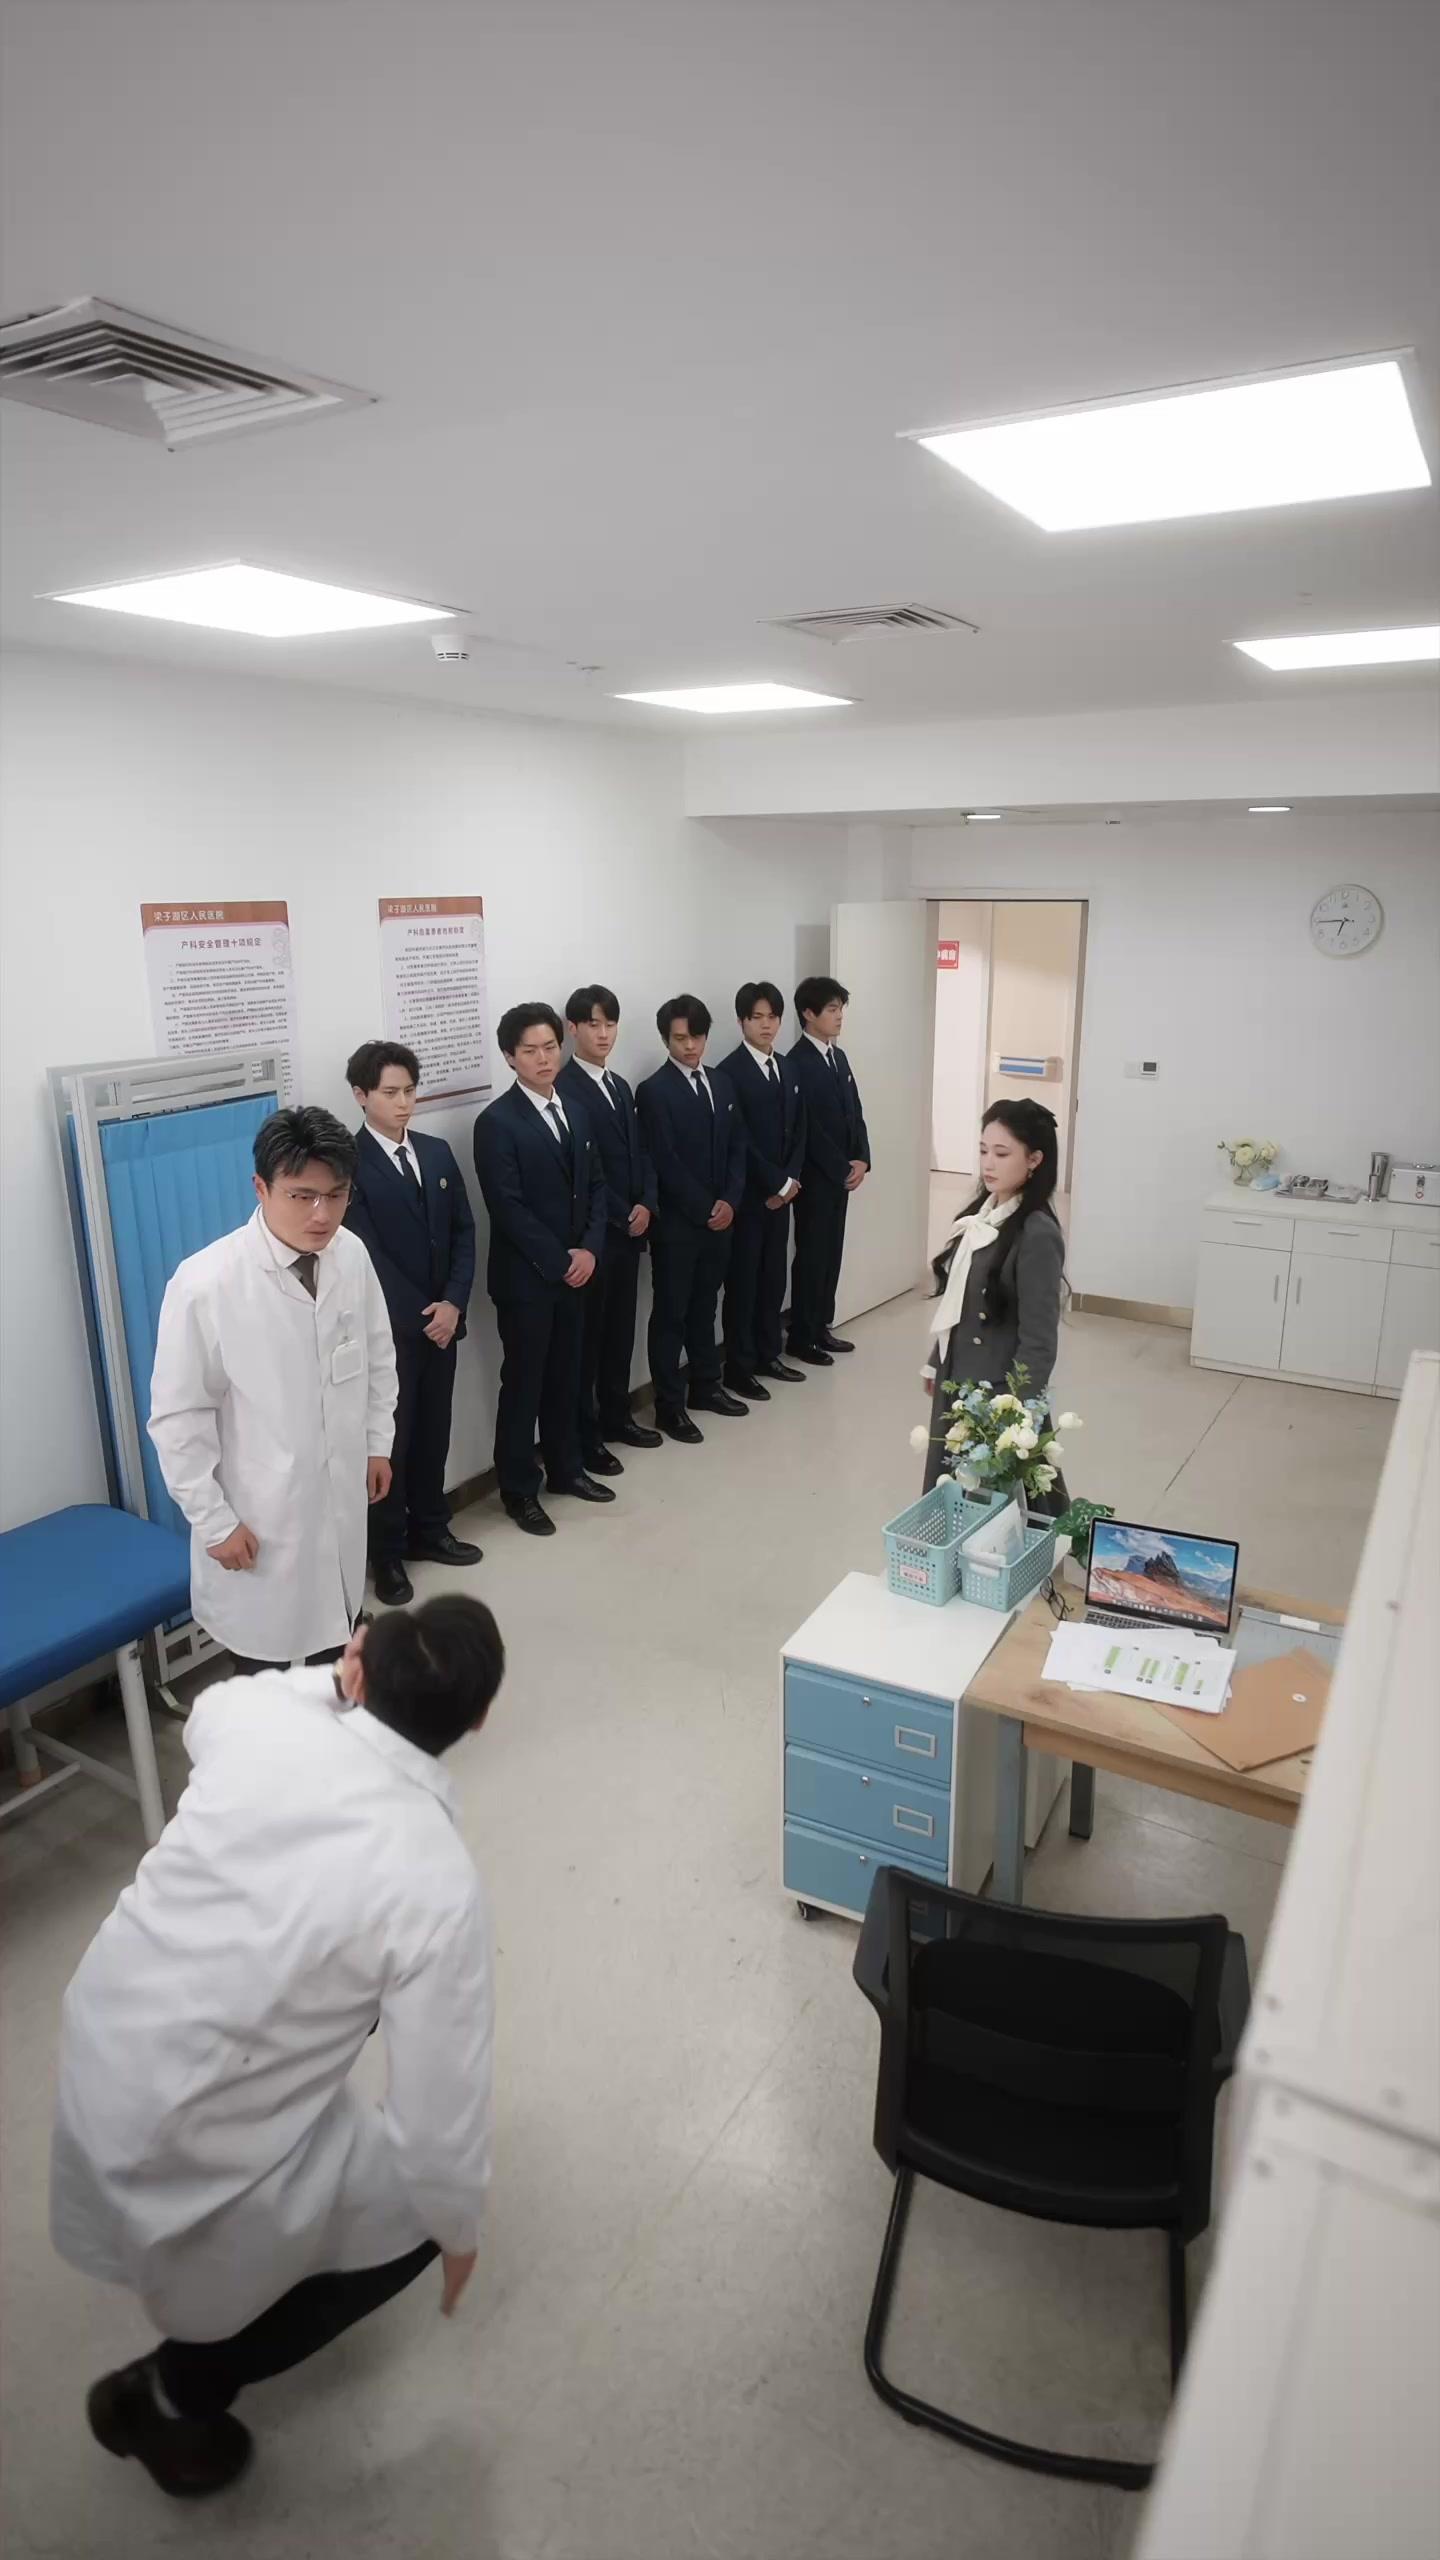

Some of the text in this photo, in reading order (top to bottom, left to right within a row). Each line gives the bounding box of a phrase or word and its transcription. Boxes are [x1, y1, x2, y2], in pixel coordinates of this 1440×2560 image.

[153, 910, 225, 922] 梁子湖区人民医院
